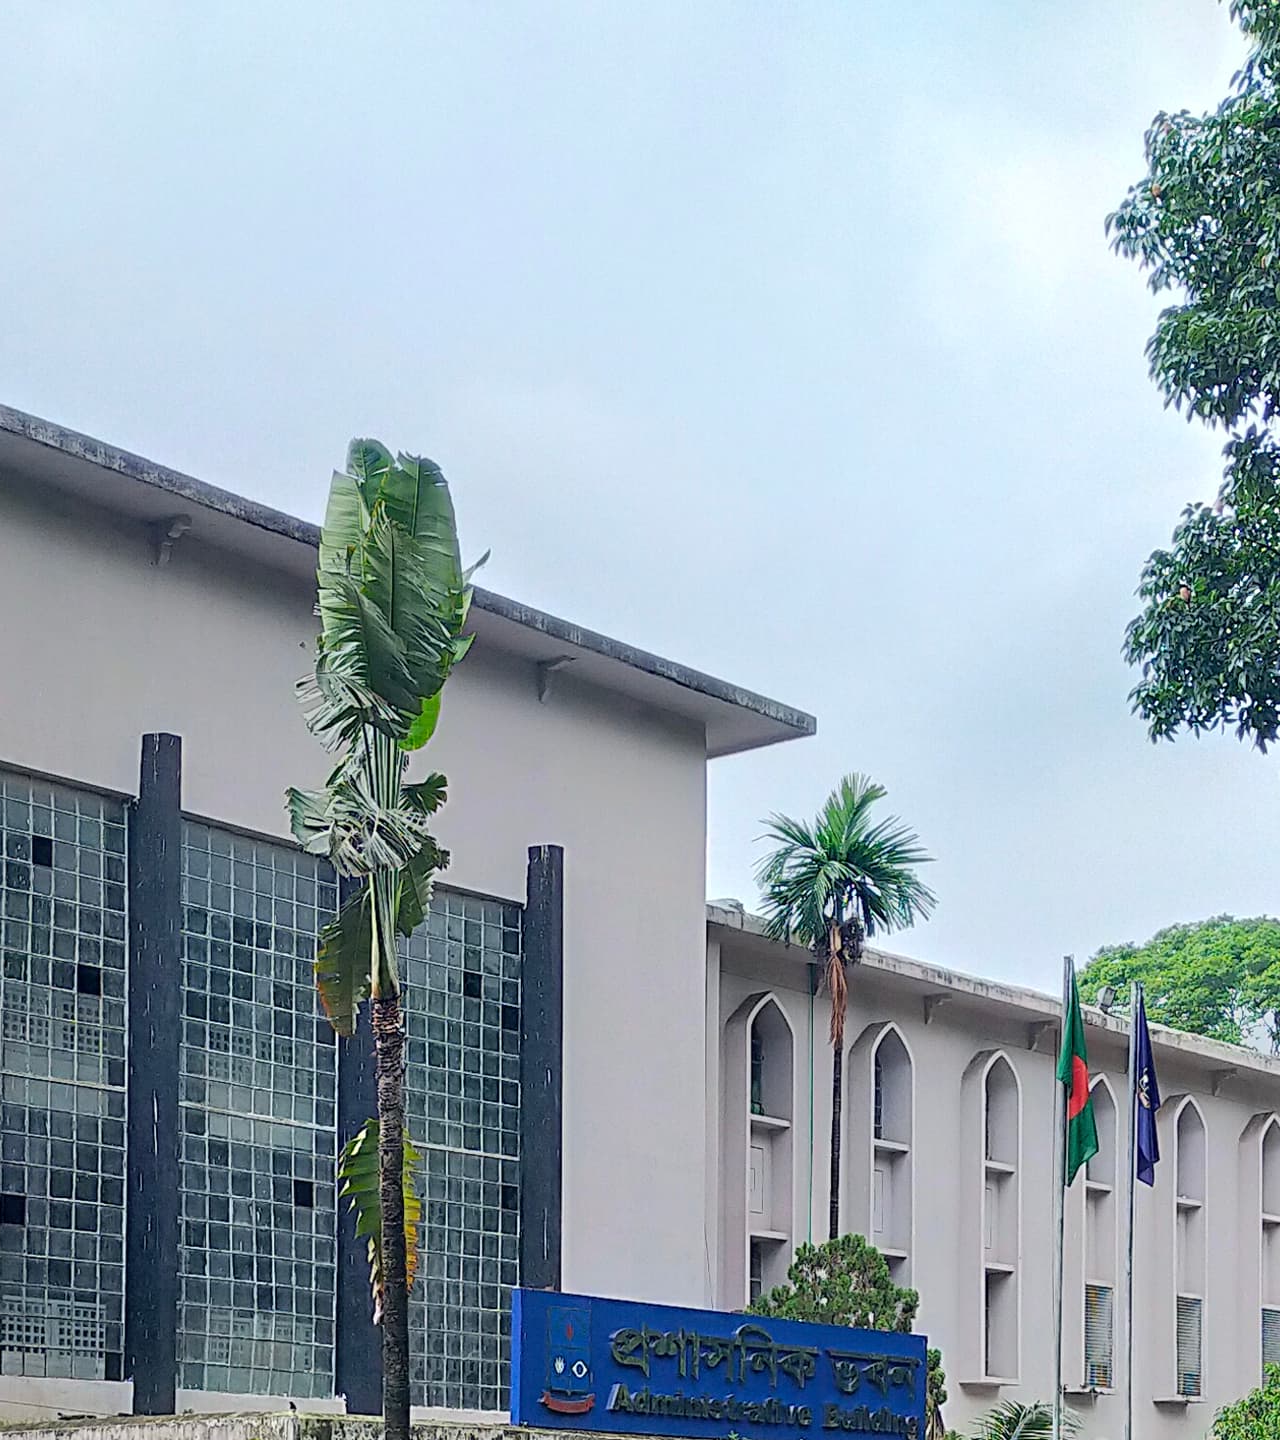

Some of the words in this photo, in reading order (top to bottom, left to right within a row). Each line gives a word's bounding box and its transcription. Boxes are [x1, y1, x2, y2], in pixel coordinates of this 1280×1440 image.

[609, 1321, 822, 1389] প্রশাসনিক
[827, 1348, 922, 1401] ভবন
[606, 1382, 812, 1427] Administrative
